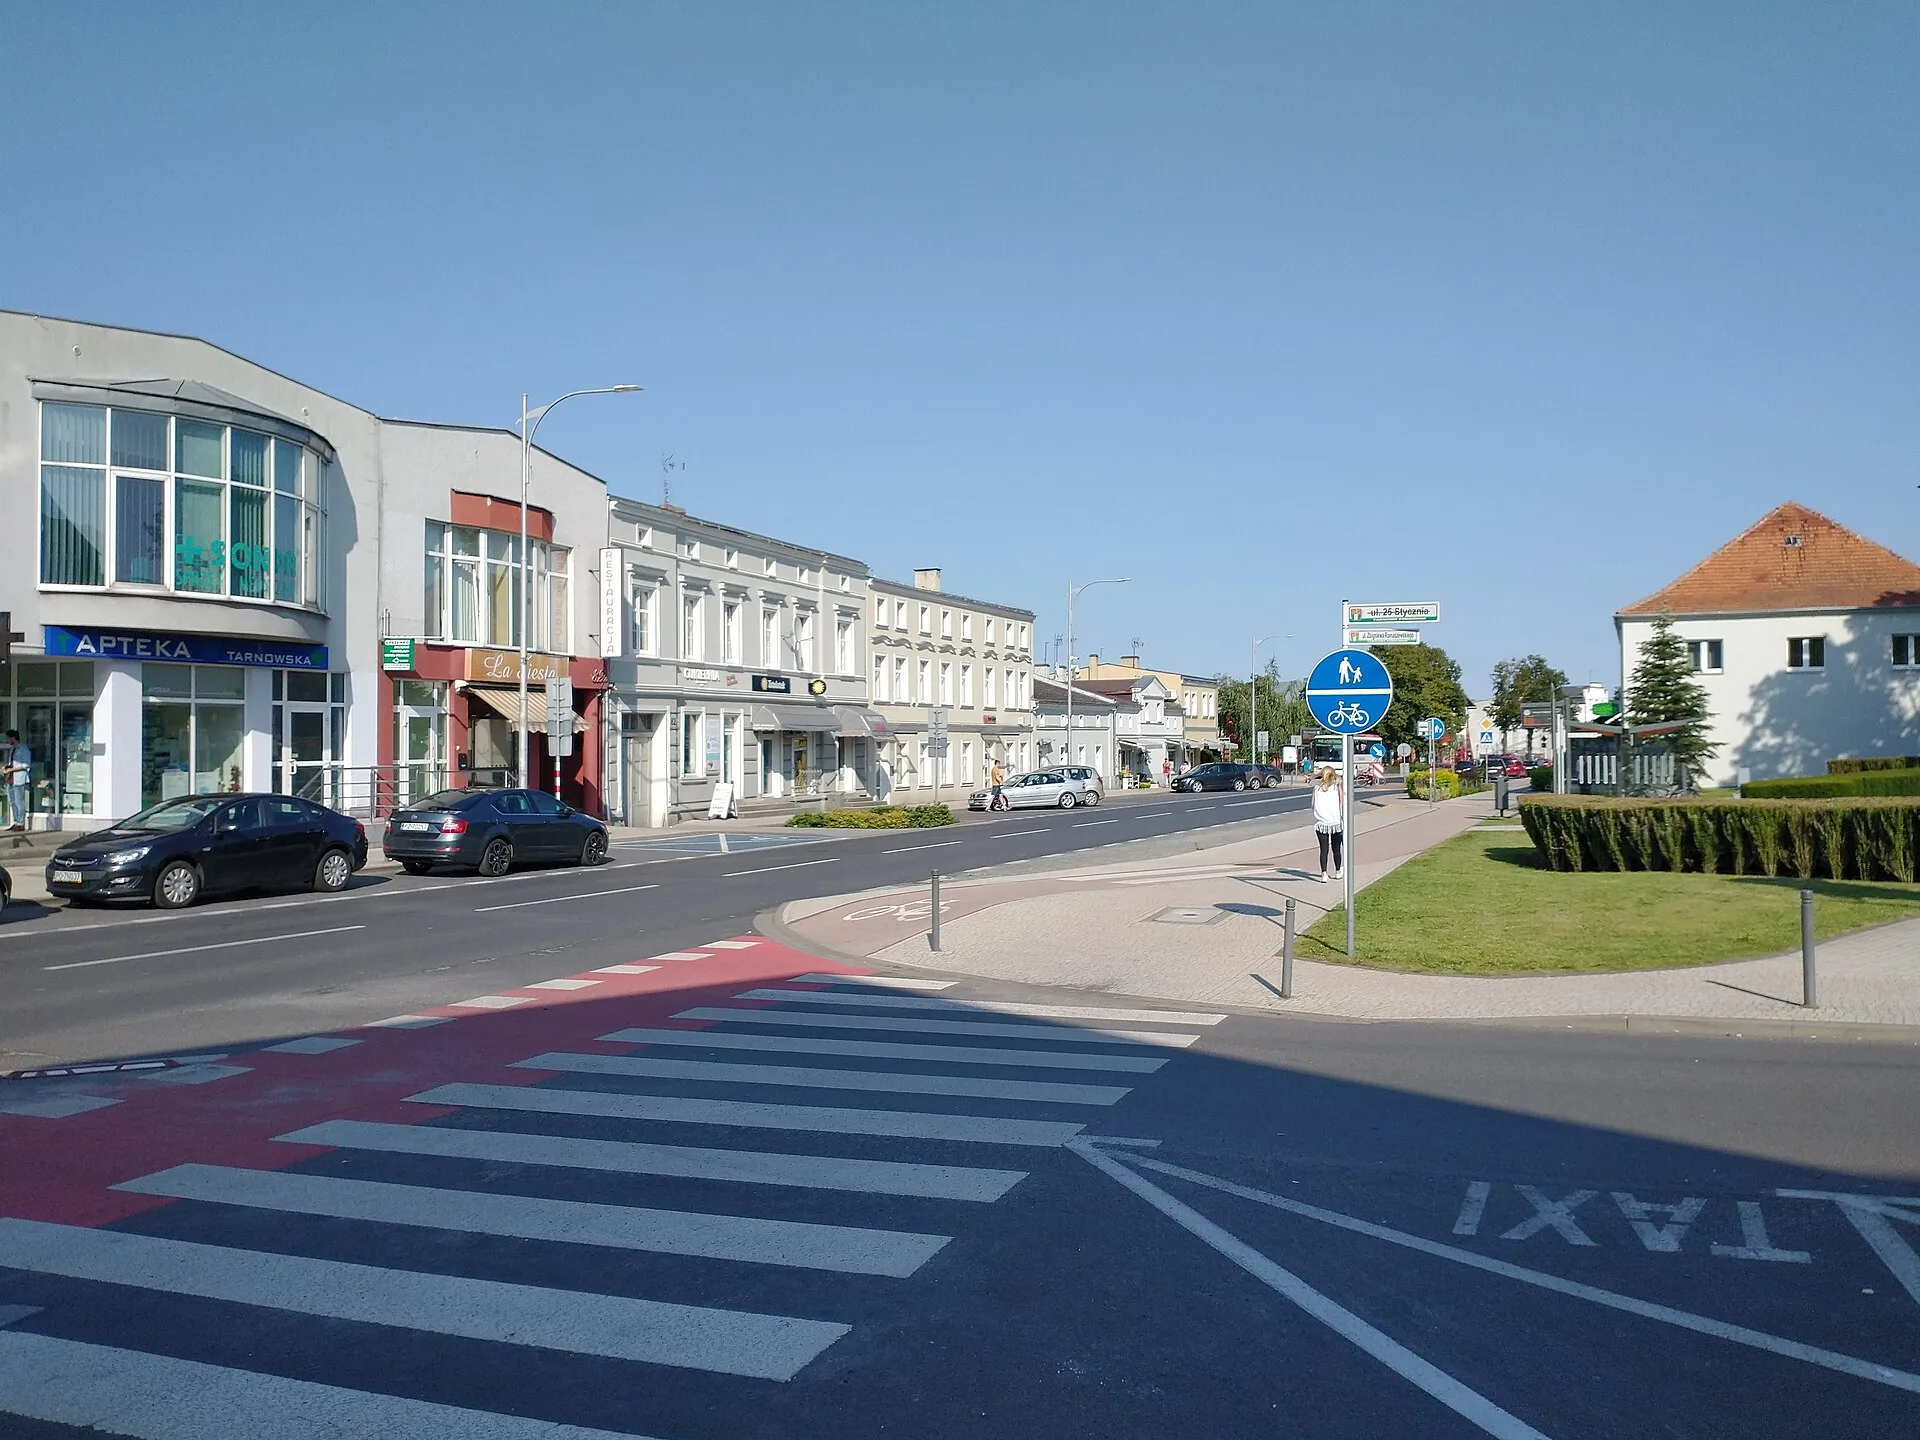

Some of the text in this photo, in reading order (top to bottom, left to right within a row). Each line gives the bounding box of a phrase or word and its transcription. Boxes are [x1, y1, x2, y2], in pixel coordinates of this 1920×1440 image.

[605, 551, 615, 653] RESTAURACJA
[1383, 608, 1393, 616] 25
[1394, 607, 1429, 618] Stycznia
[75, 634, 312, 666] APTEKA TARNOWSKA
[484, 652, 512, 678] La
[1452, 1181, 1813, 1264] TAXI
